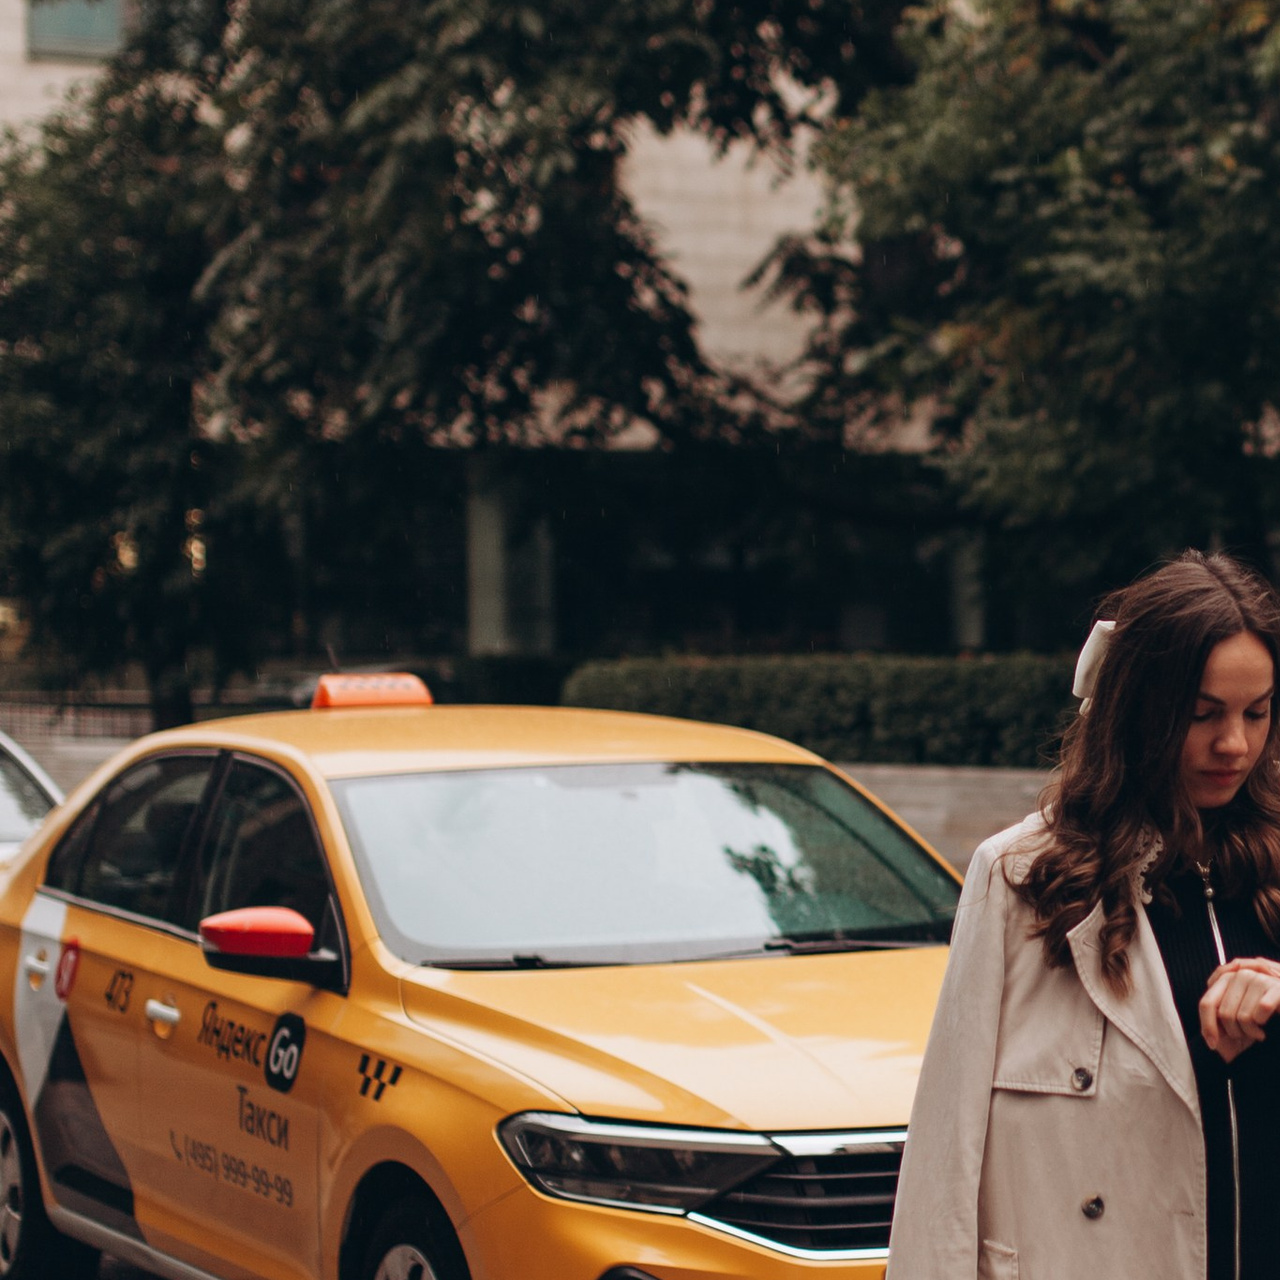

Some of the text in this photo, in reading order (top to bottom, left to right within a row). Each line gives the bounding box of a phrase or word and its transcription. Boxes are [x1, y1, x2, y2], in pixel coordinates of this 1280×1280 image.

[199, 1001, 299, 1079] Яндекс Go
[237, 1085, 289, 1151] Такси
[183, 1134, 219, 1181] (495)
